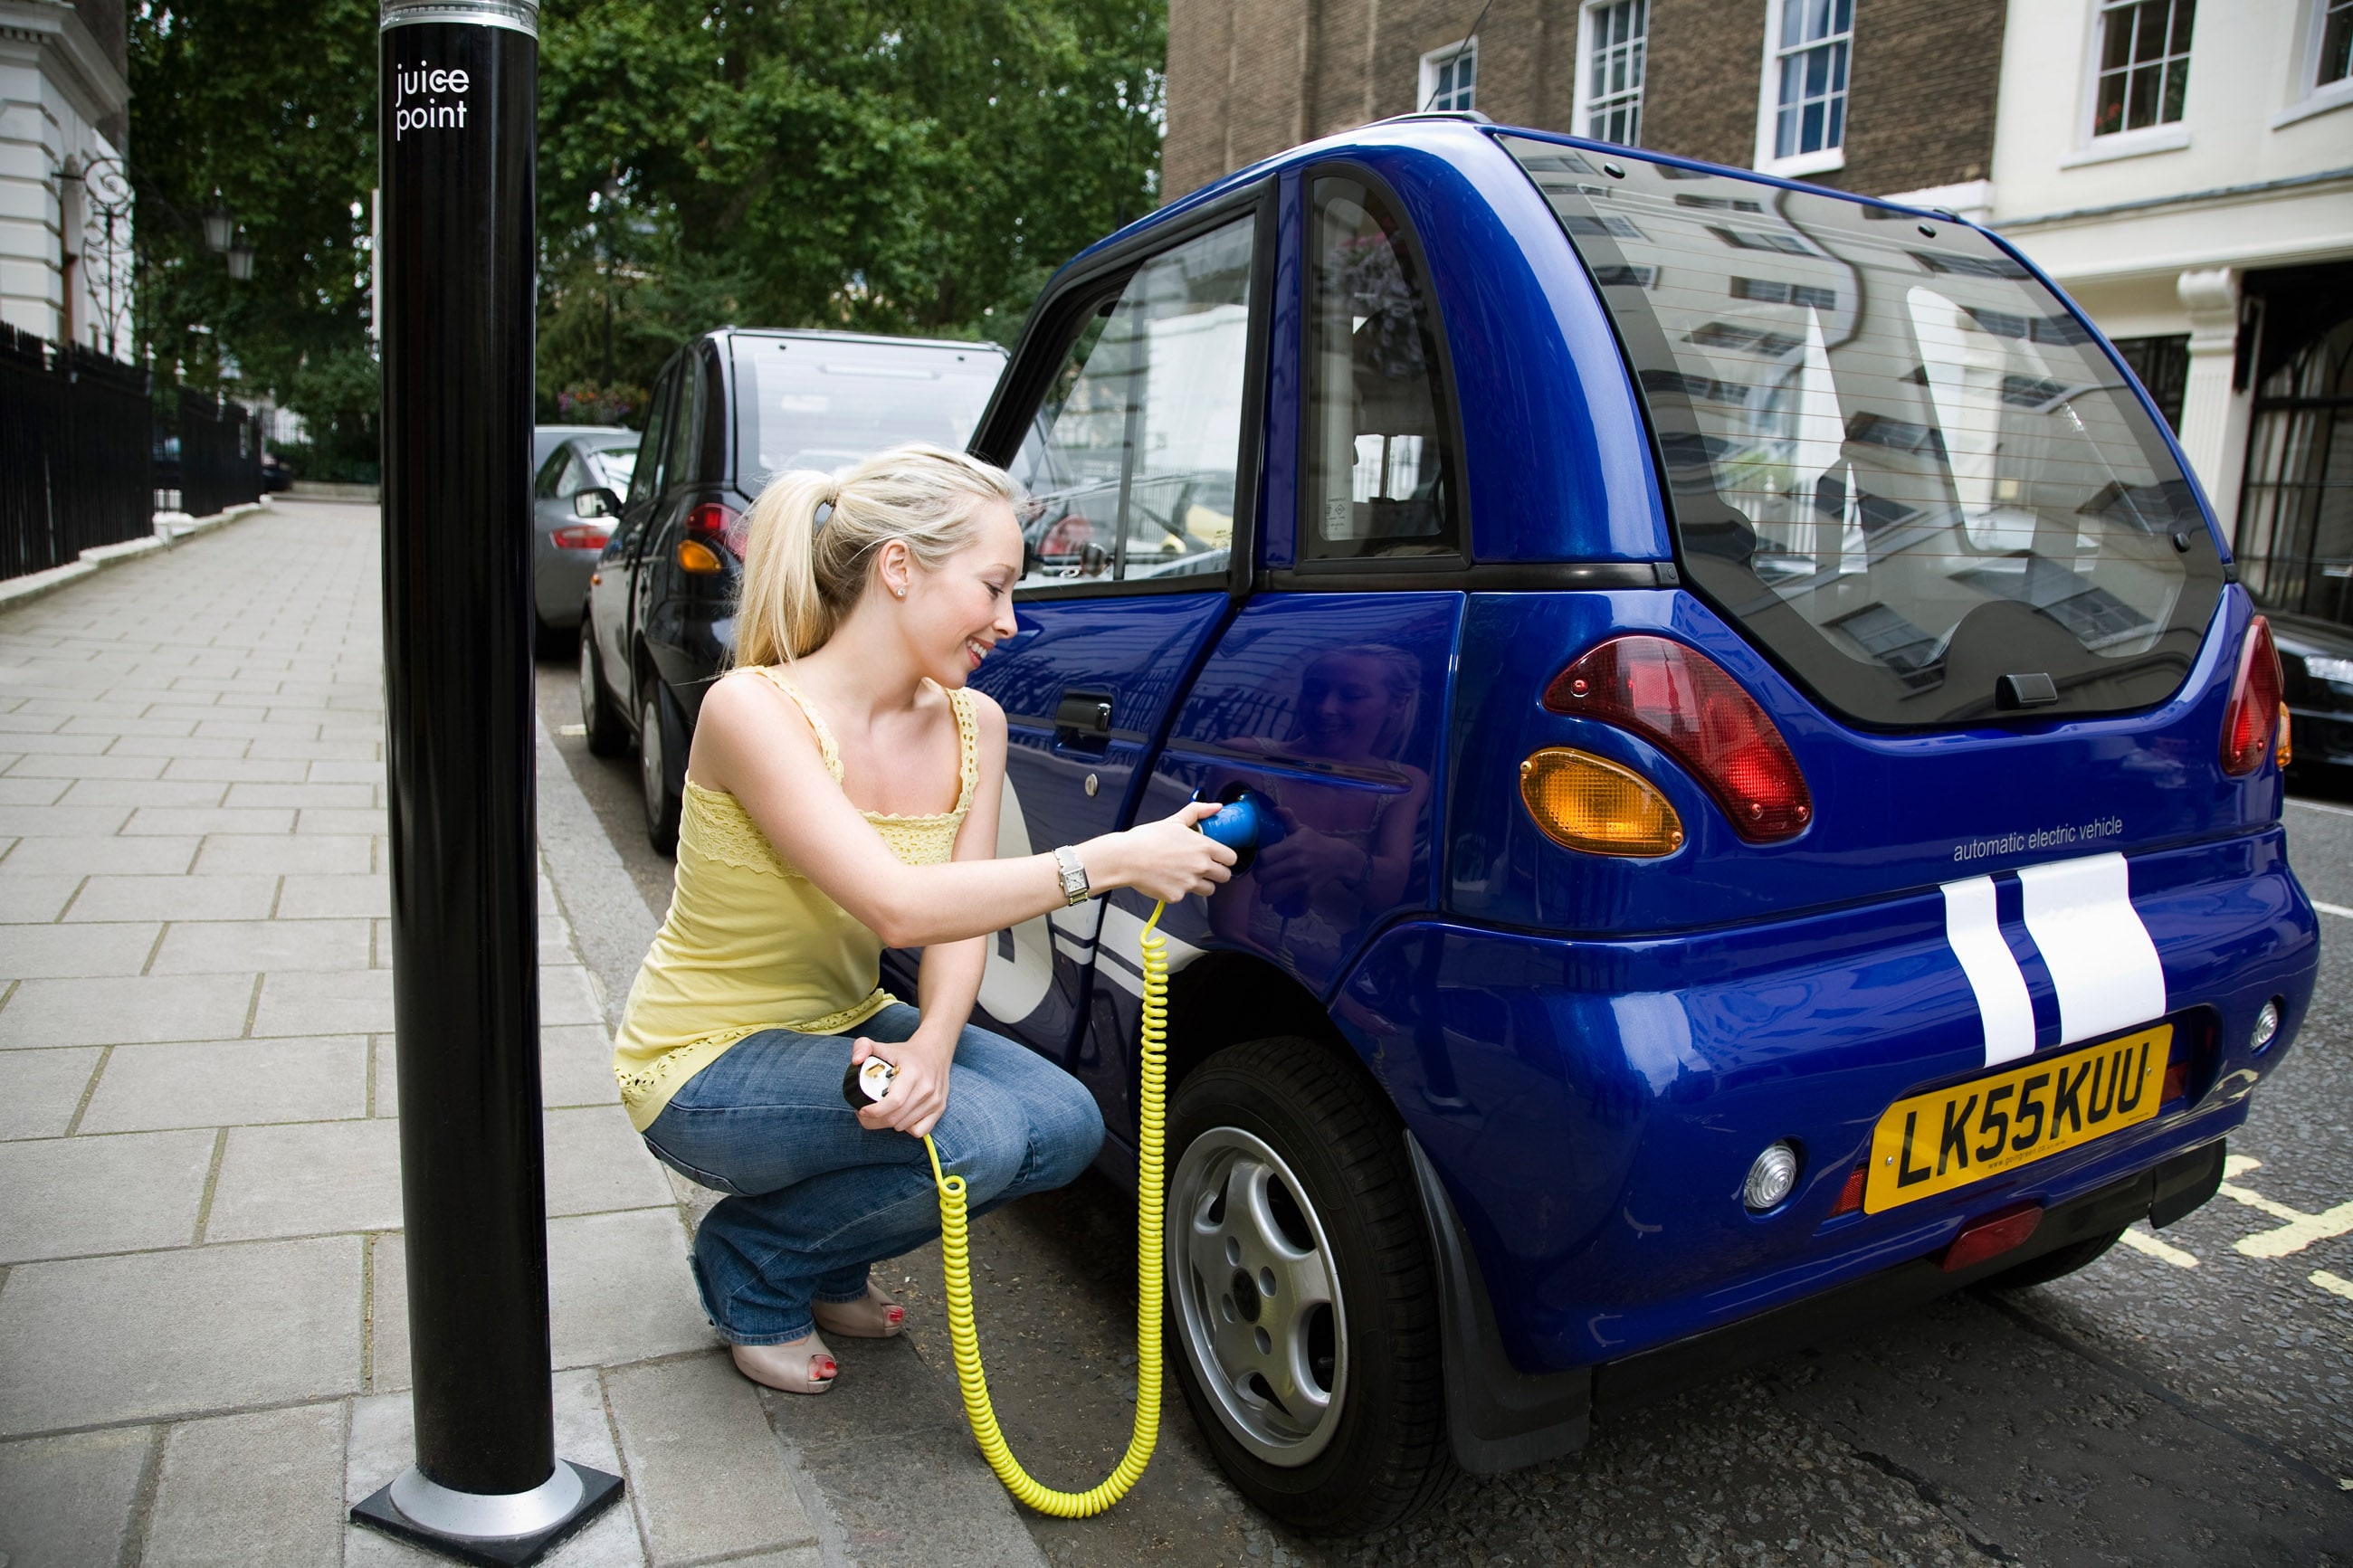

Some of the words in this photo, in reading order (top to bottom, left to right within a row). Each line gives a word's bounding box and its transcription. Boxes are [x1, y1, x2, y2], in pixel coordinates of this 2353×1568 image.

[395, 60, 470, 108] juice
[395, 98, 468, 142] point
[1953, 832, 2024, 862] automatic
[2028, 822, 2076, 850] electric
[2080, 815, 2123, 841] vehicle
